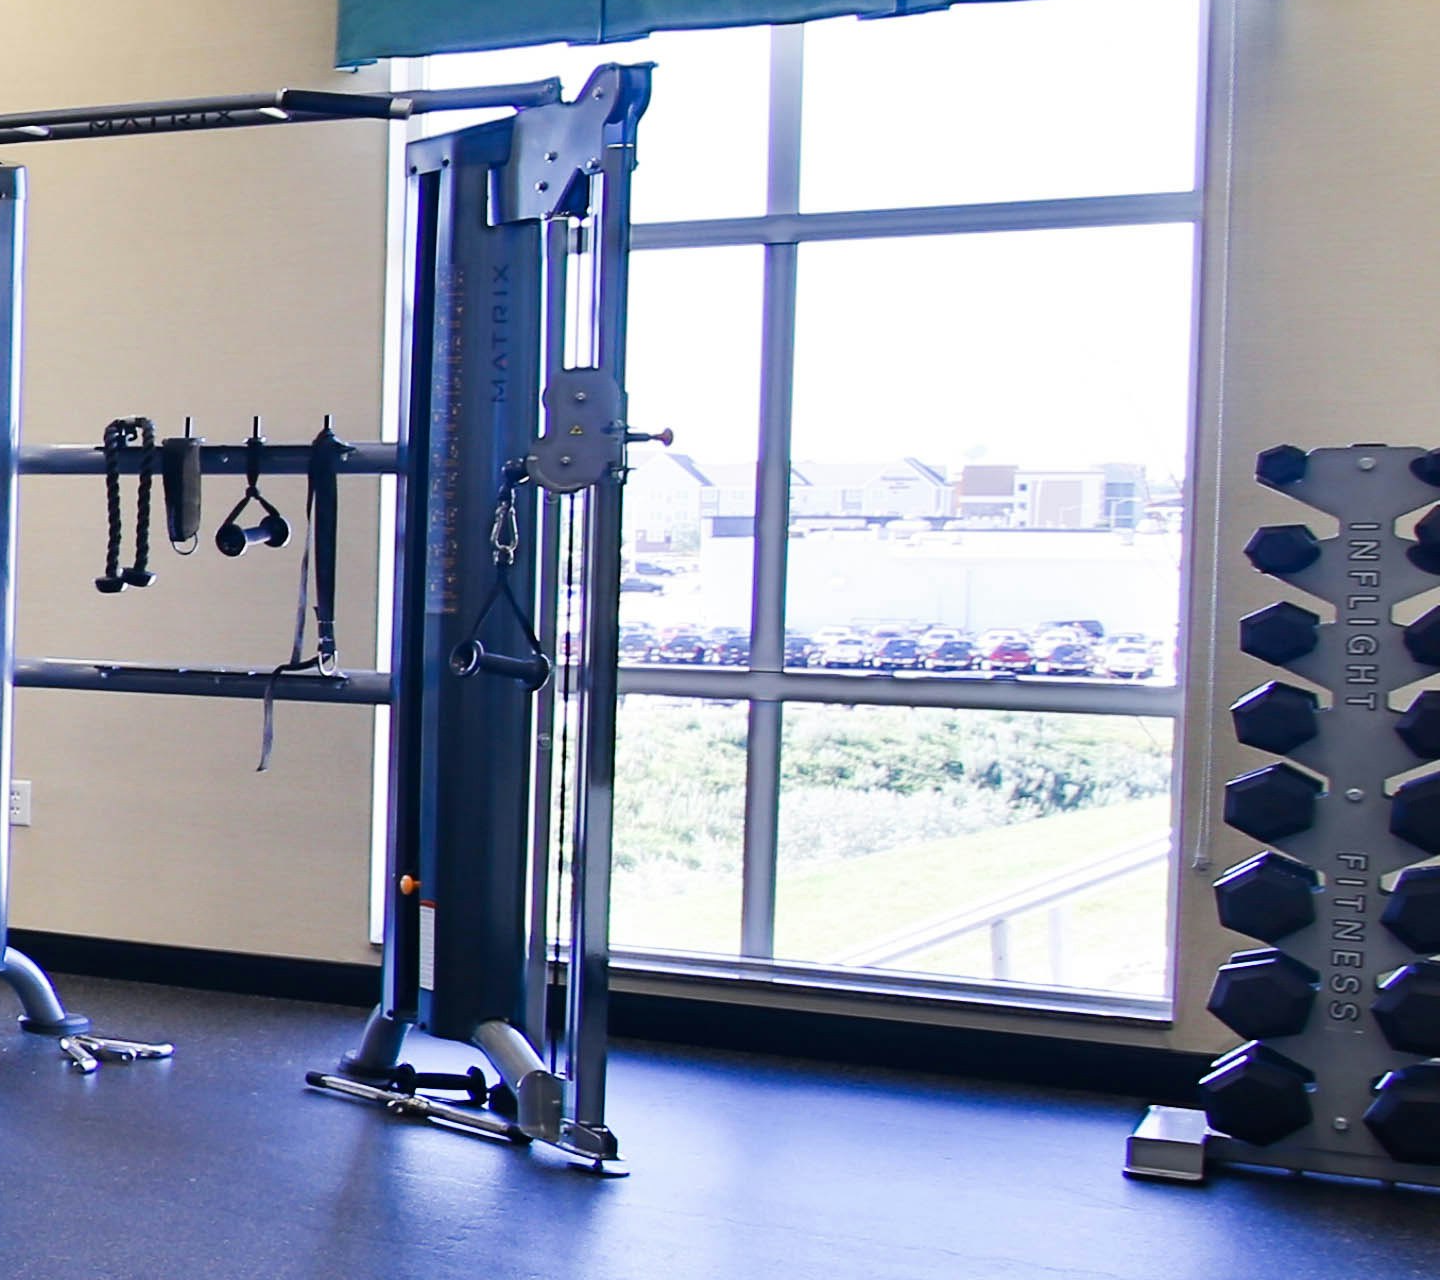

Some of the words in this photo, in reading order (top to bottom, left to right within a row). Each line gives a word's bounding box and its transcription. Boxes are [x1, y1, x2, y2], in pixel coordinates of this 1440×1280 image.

[88, 109, 236, 133] MATRIX
[490, 264, 509, 403] MATRIX
[1346, 522, 1380, 711] INFLIGHT
[1330, 852, 1369, 1022] FITNESS
